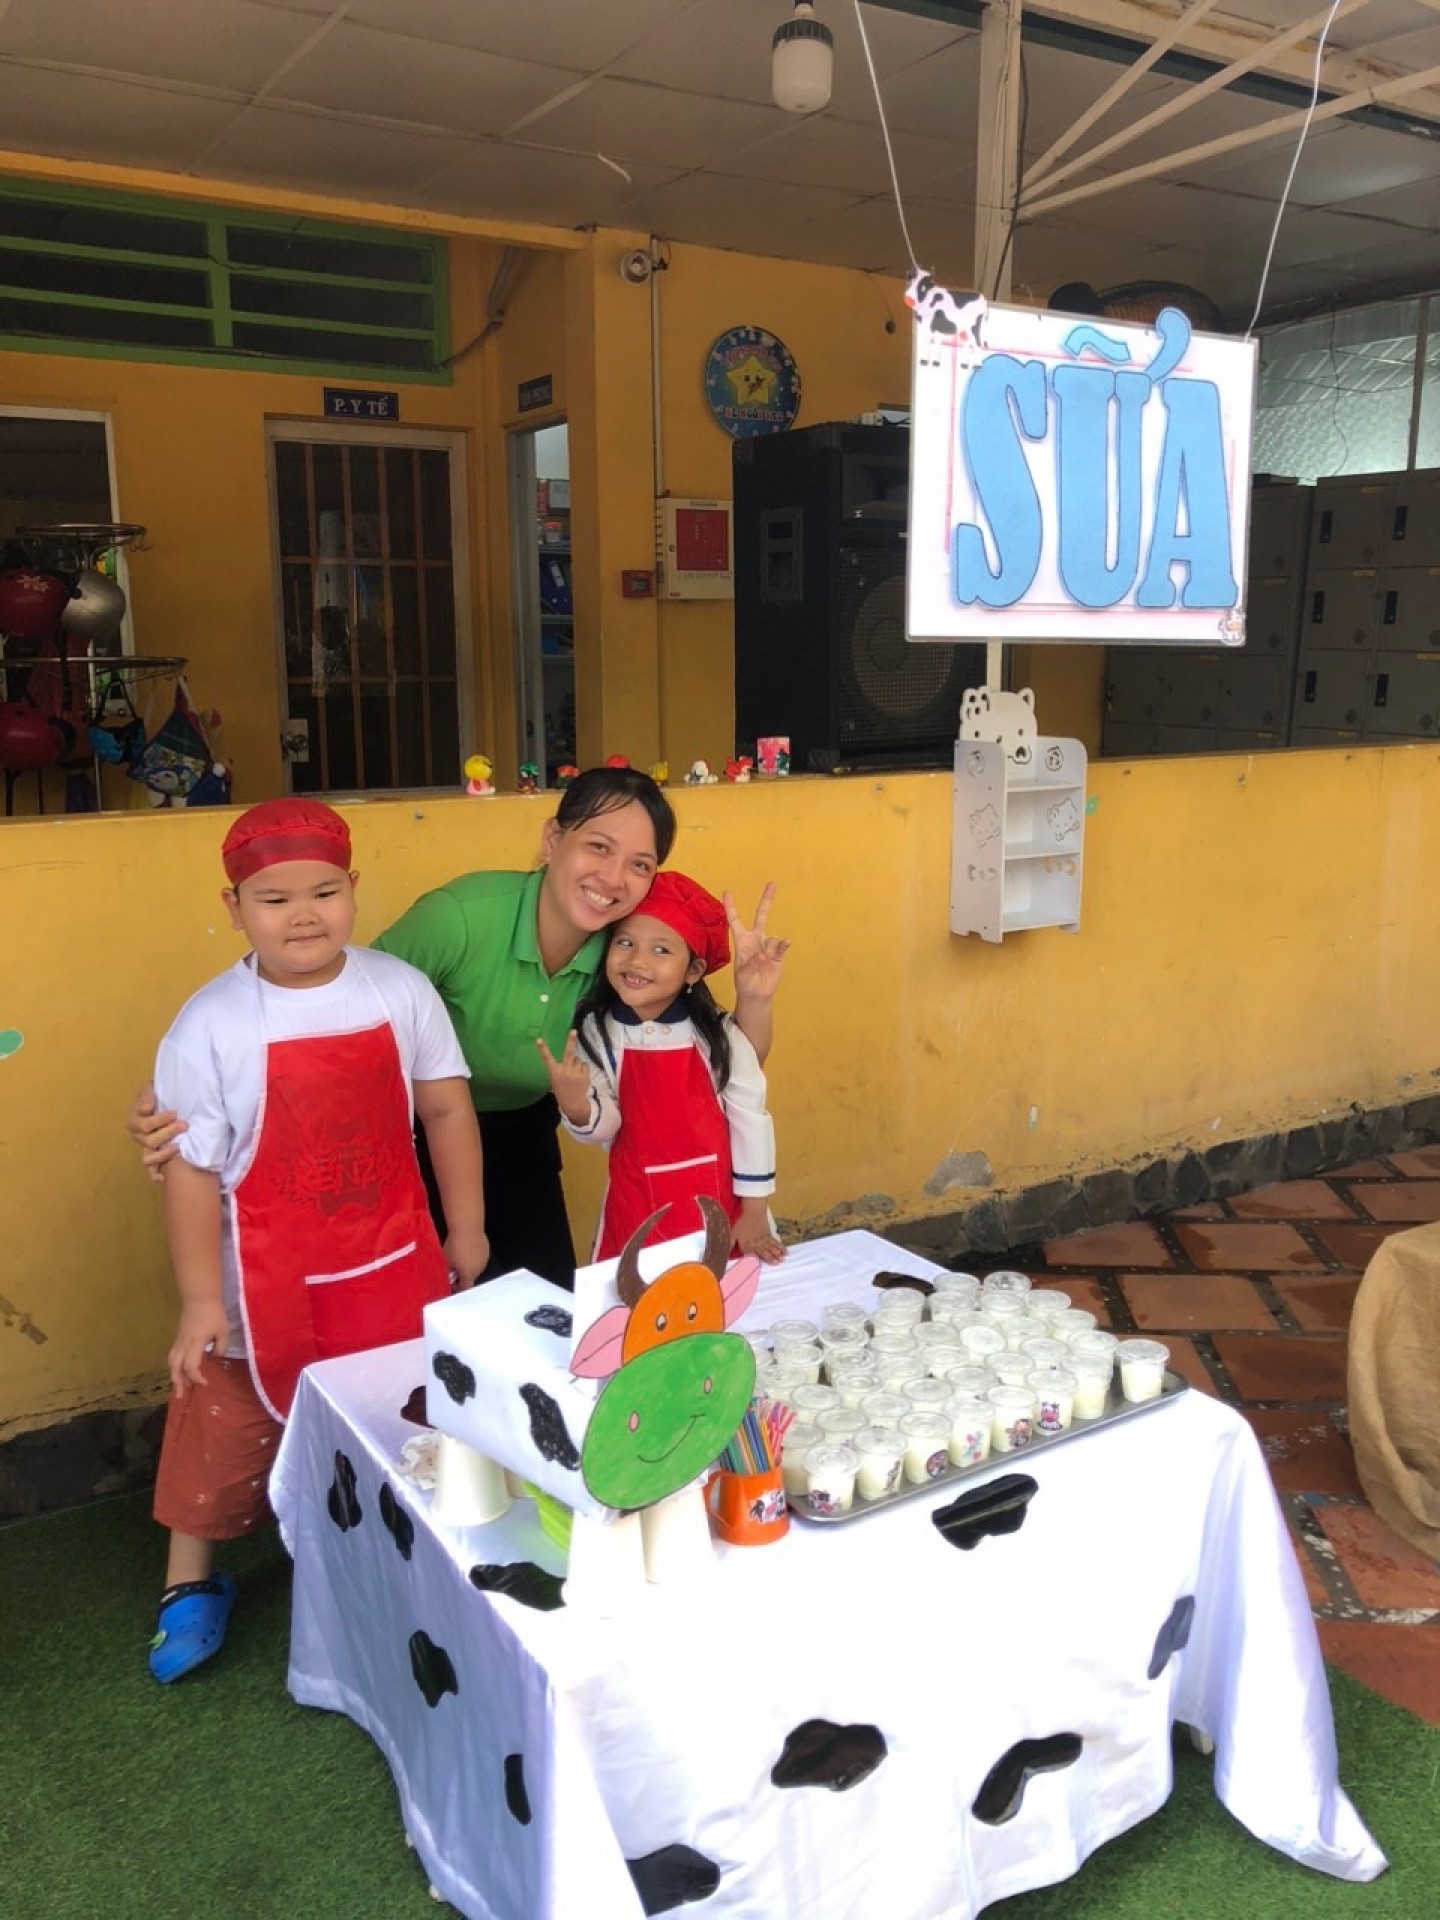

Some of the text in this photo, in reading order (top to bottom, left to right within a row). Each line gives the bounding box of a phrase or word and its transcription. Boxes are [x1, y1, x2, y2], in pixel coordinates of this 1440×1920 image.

[334, 396, 388, 415] P. Y TẾ
[956, 308, 1239, 608] SỮA
